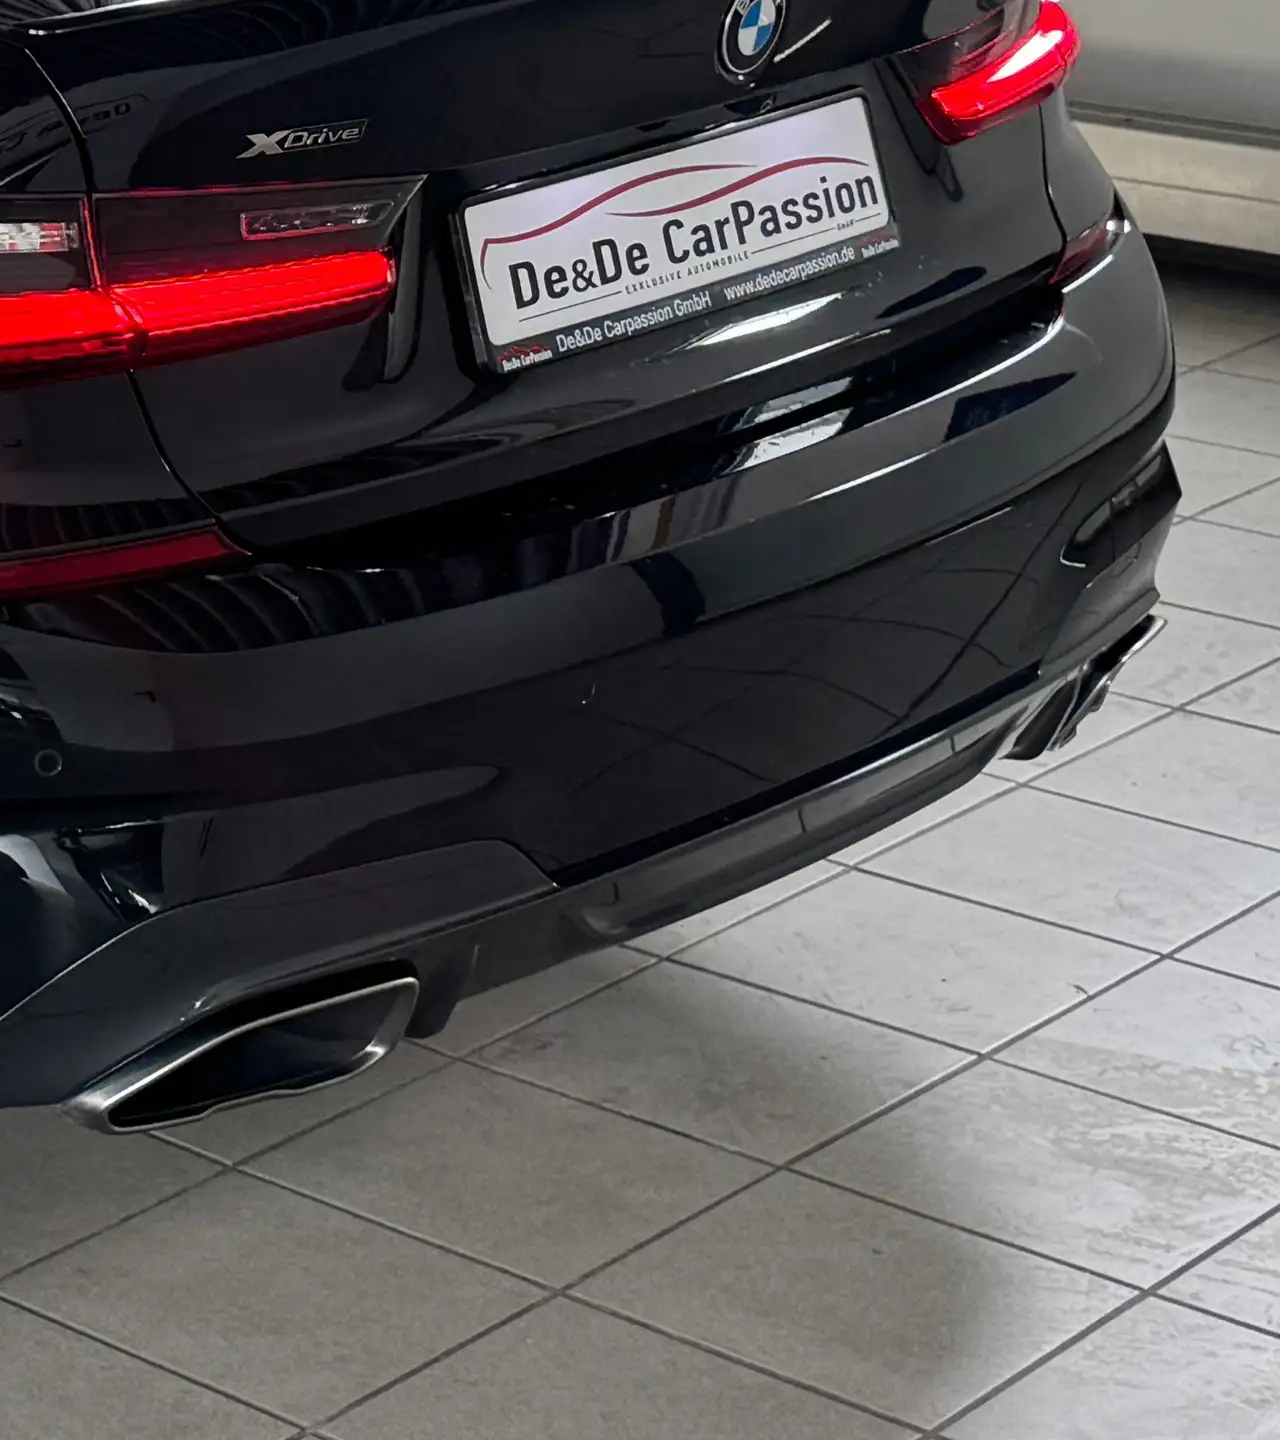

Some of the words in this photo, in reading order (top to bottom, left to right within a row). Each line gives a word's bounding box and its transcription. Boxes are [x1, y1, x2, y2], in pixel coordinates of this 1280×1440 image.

[508, 239, 650, 310] De&De
[663, 175, 879, 264] CarPassion
[687, 250, 749, 277] AUTOMOBILE
[556, 325, 603, 353] De&De
[603, 304, 674, 343] Carpassion
[674, 290, 712, 317] GmbH
[724, 245, 856, 302] www.dedecarpassion.de
